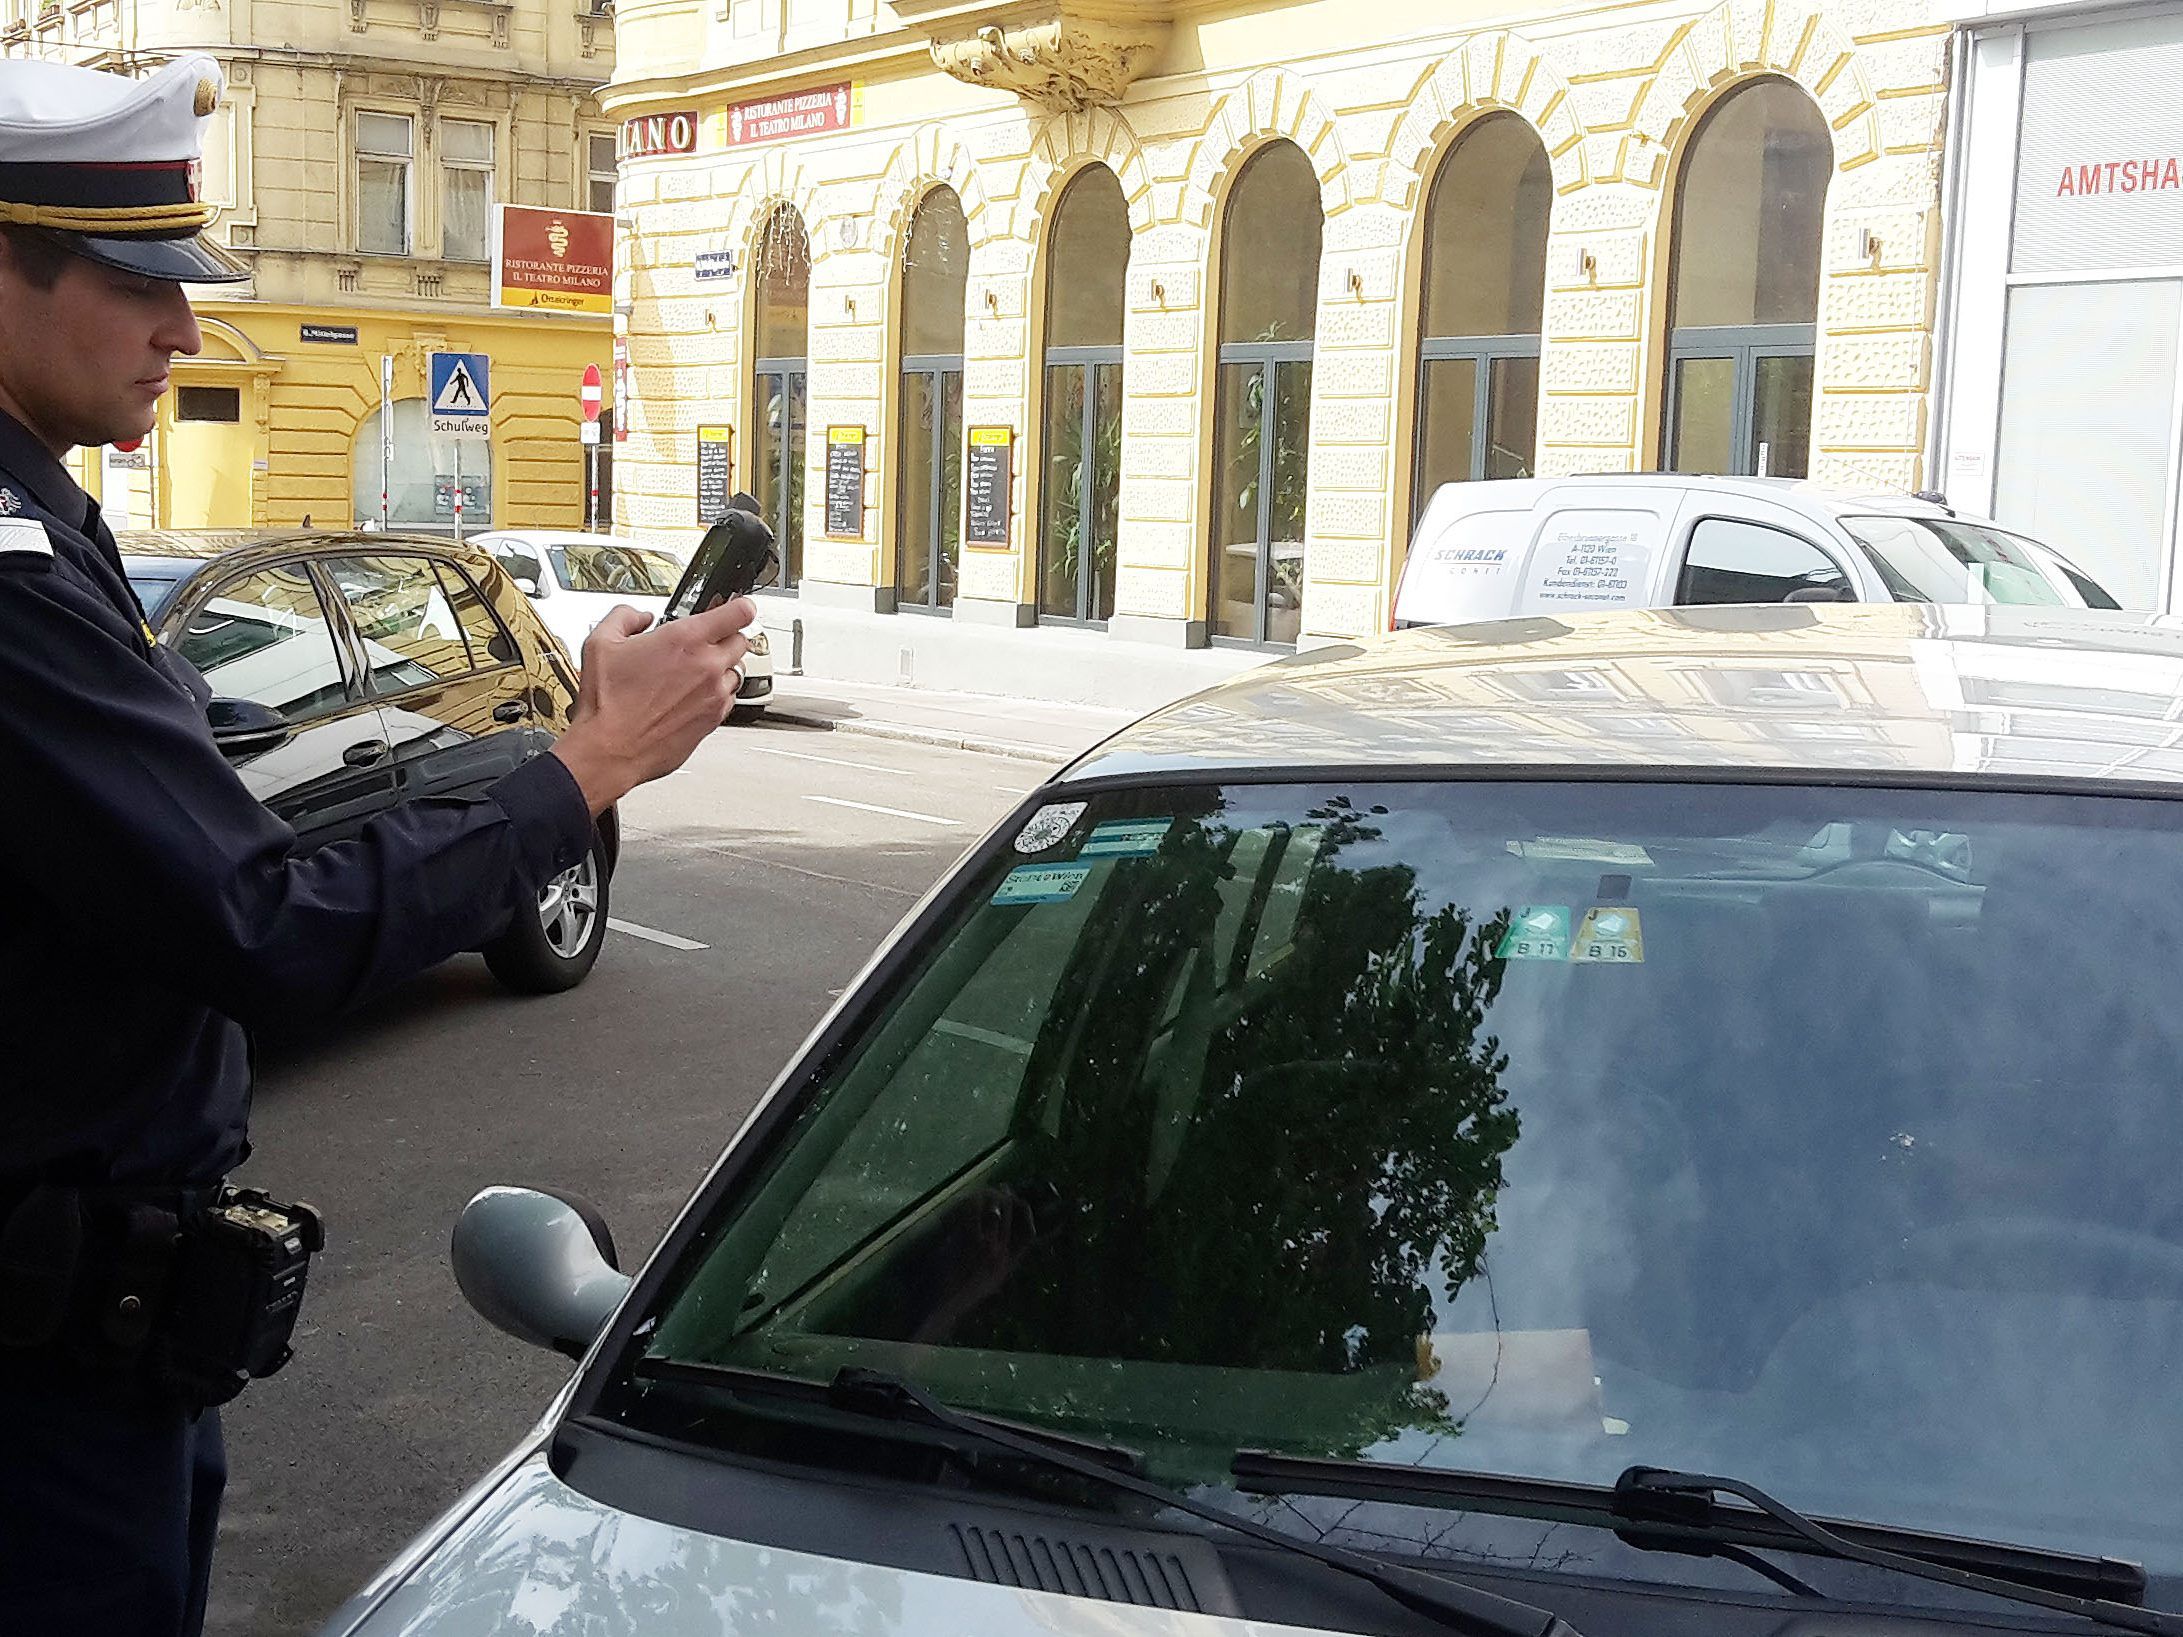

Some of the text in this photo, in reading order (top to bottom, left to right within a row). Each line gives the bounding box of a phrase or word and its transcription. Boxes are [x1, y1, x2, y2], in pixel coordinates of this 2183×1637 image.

[744, 99, 794, 121] RISTORANTE
[794, 92, 832, 112] PIZZERIA
[750, 111, 825, 138] IL TEATRO MILANO
[2056, 158, 2180, 197] AMTSHA
[505, 258, 609, 277] RISTORANTE PIZZERIA
[513, 271, 601, 288] IL TEATRO MILANO
[433, 419, 488, 435] Schulweg
[1434, 549, 1507, 561] SCHRACK
[1557, 566, 1571, 575] Fax
